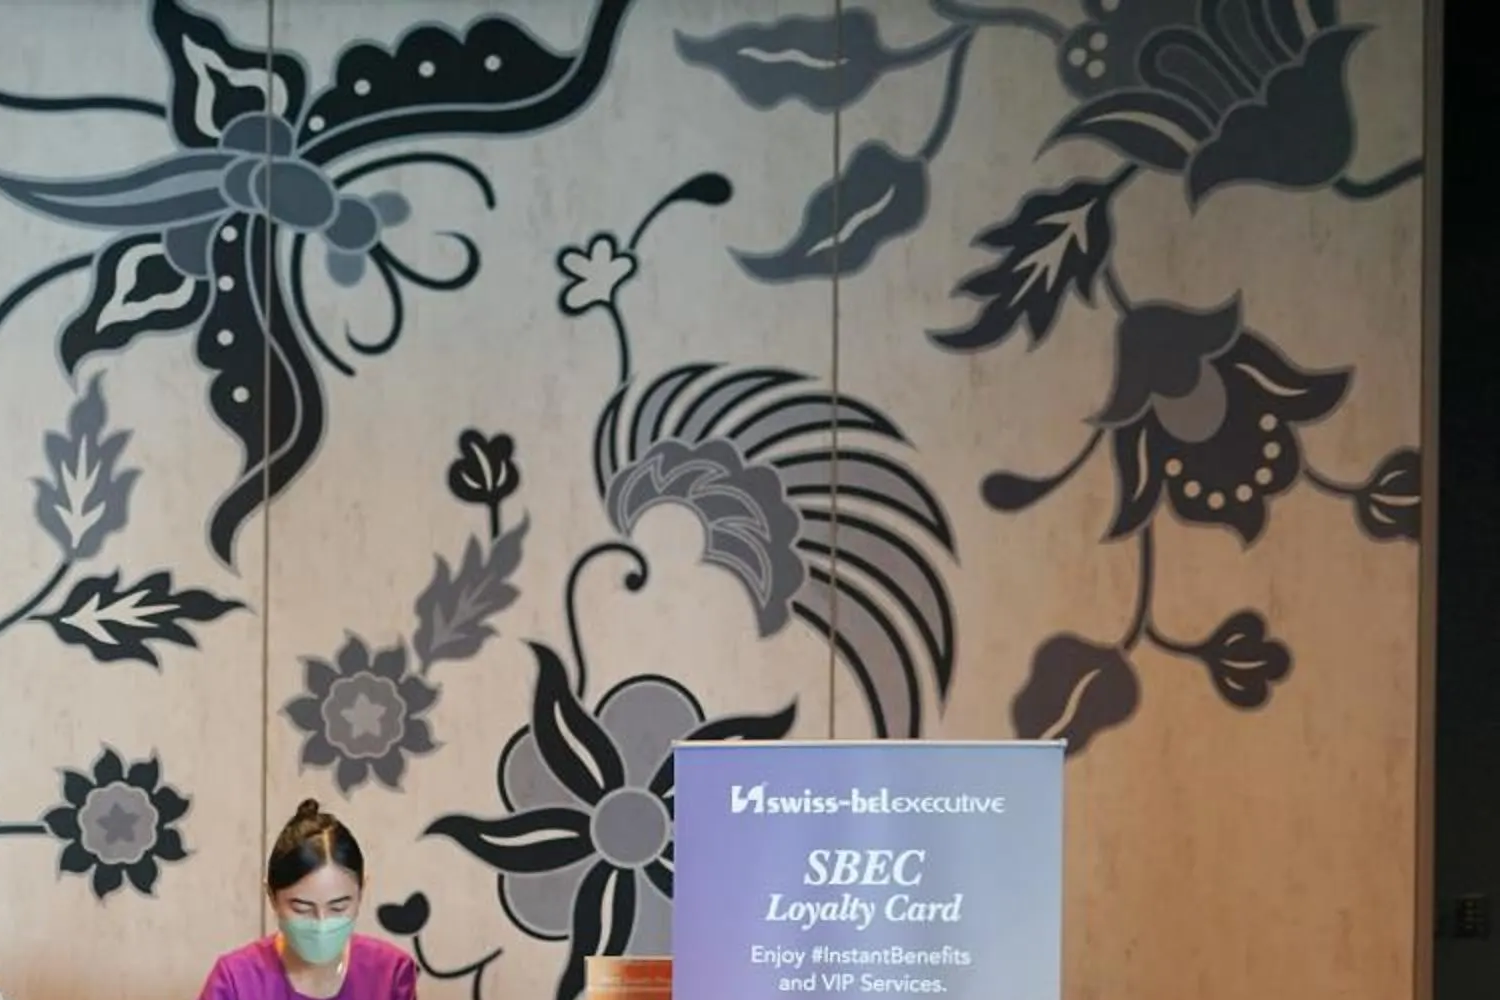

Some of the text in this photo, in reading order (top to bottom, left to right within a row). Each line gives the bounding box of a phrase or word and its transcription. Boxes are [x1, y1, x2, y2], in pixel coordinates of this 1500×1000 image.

[804, 849, 925, 886] SBEC
[765, 893, 963, 930] Loyalty Card
[751, 945, 971, 968] Enjoy #InstantBenefits
[779, 973, 947, 993] and VIP Services.
